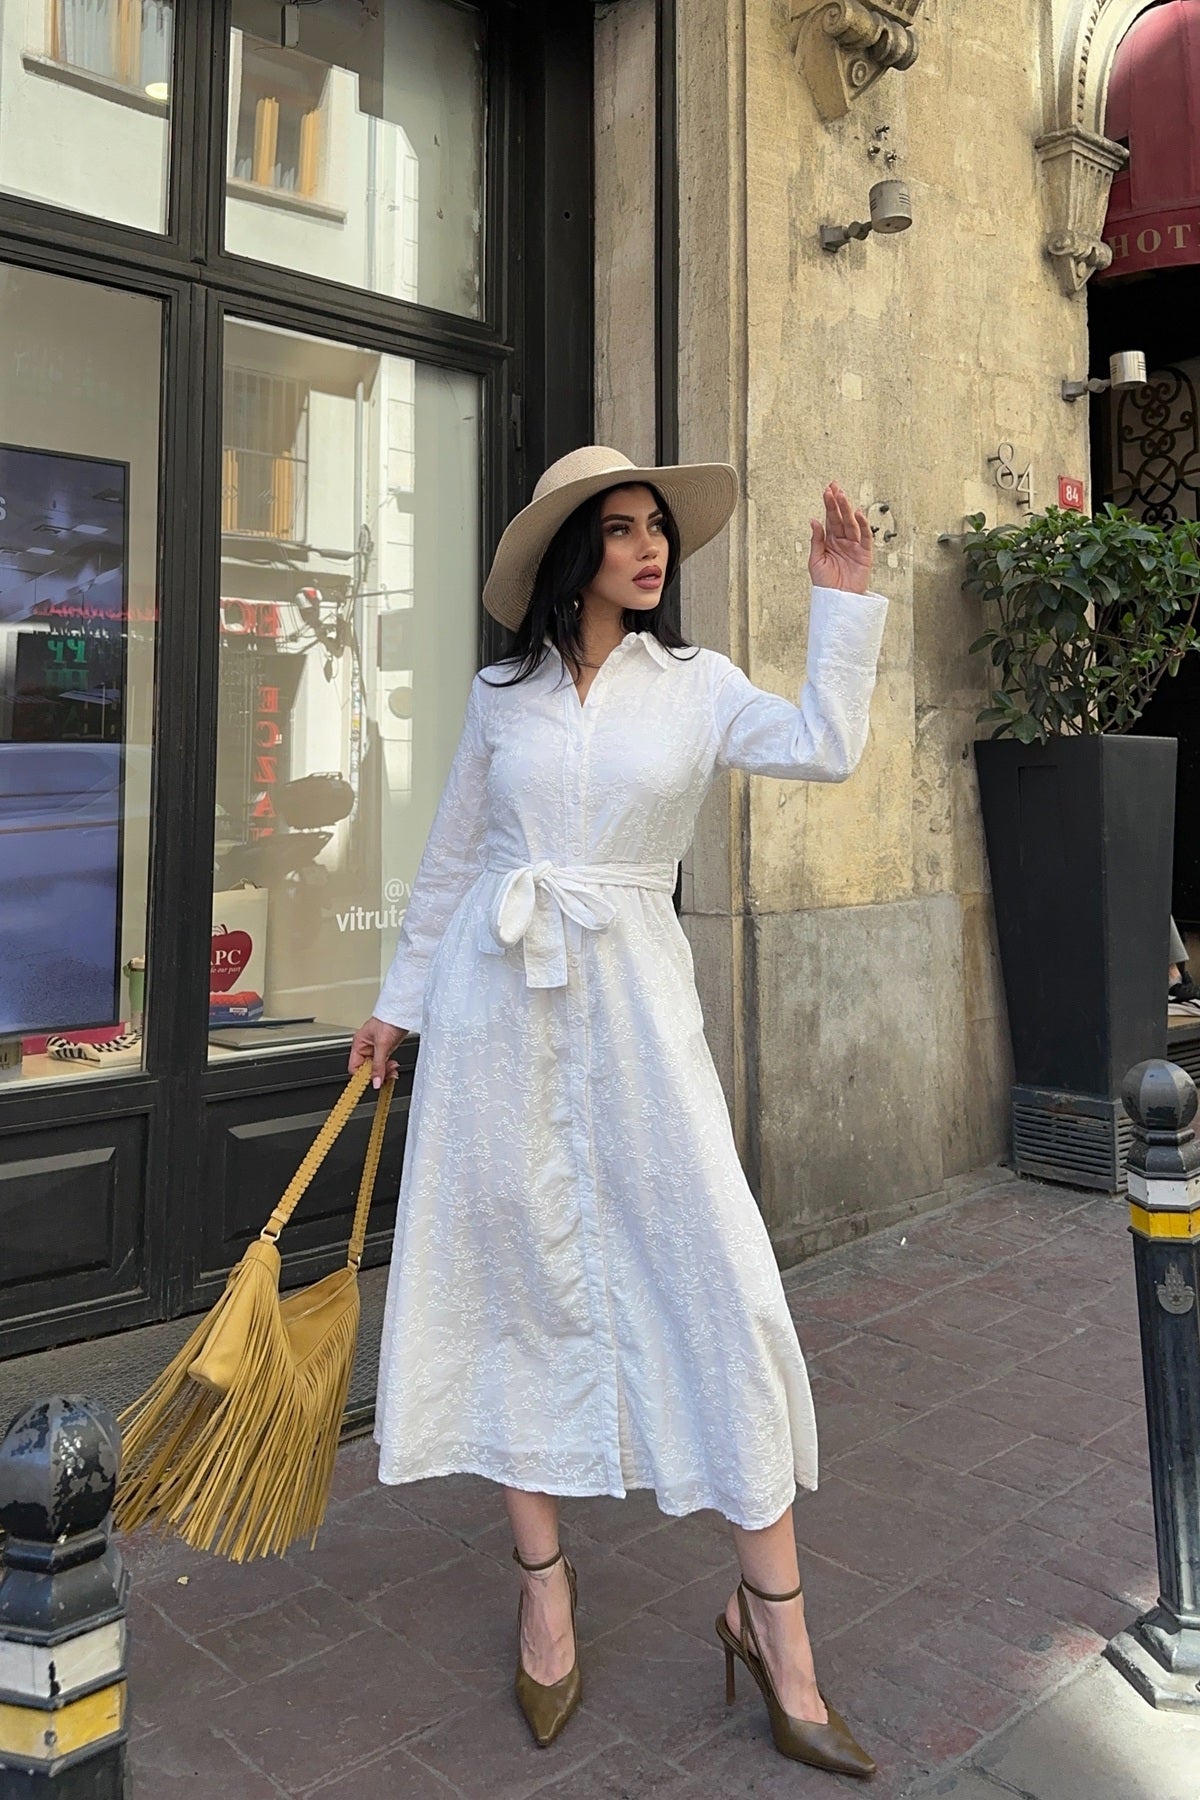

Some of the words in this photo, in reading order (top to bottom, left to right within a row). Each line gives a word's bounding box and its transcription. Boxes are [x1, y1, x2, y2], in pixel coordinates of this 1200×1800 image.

[1106, 223, 1200, 260] HOT
[996, 443, 1038, 509] 84
[1065, 485, 1079, 503] 84
